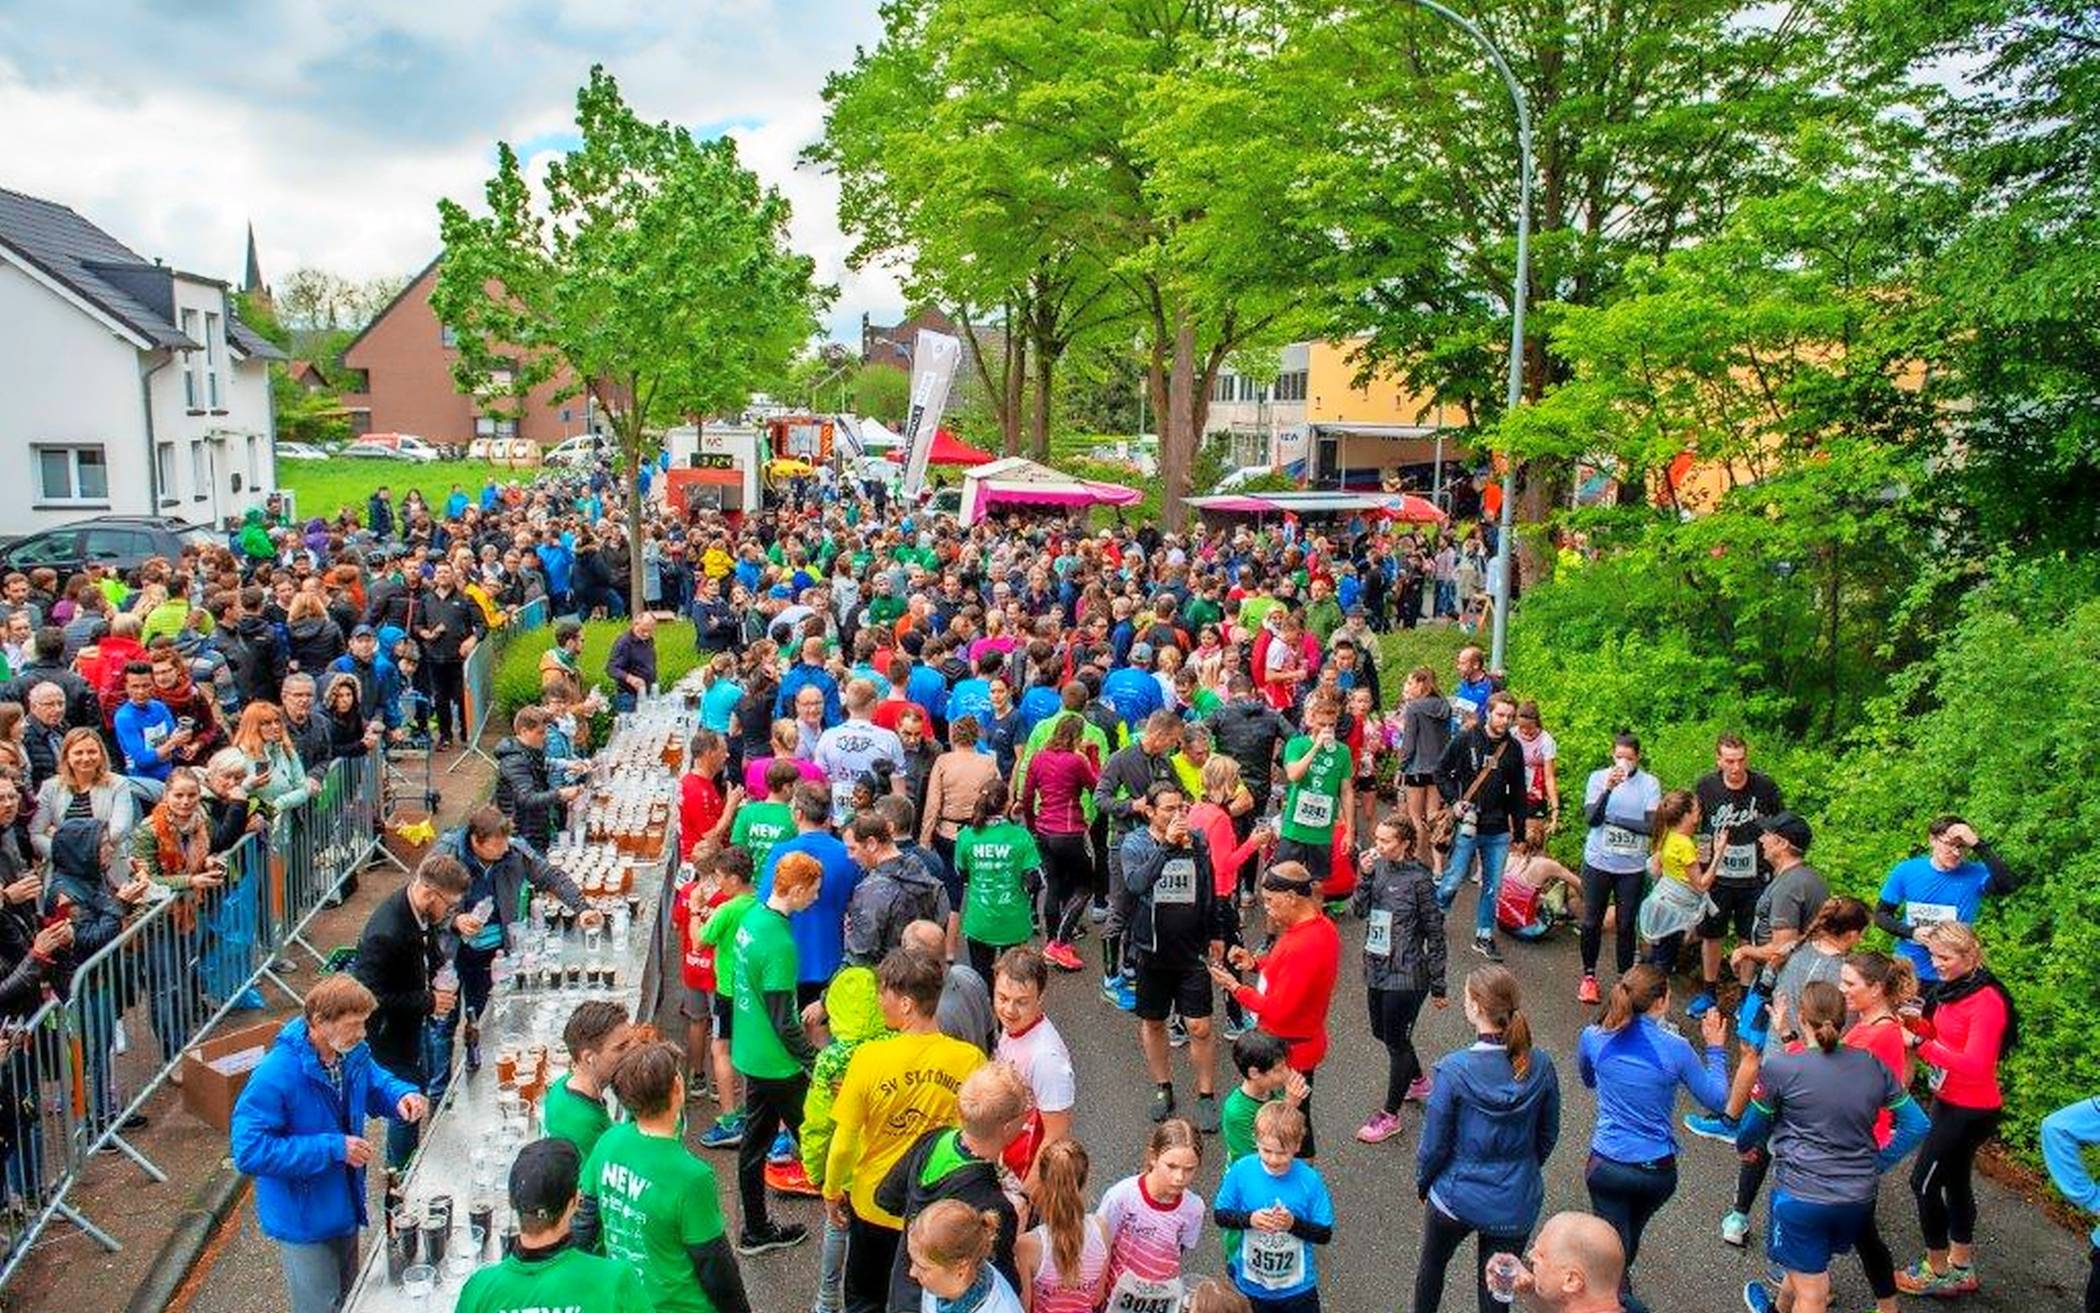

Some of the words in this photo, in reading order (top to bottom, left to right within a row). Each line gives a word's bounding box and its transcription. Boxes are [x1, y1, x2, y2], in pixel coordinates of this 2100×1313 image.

[749, 823, 785, 839] NEW
[972, 843, 1012, 859] NEW
[880, 1077, 898, 1097] SV
[1252, 1247, 1295, 1272] 3572
